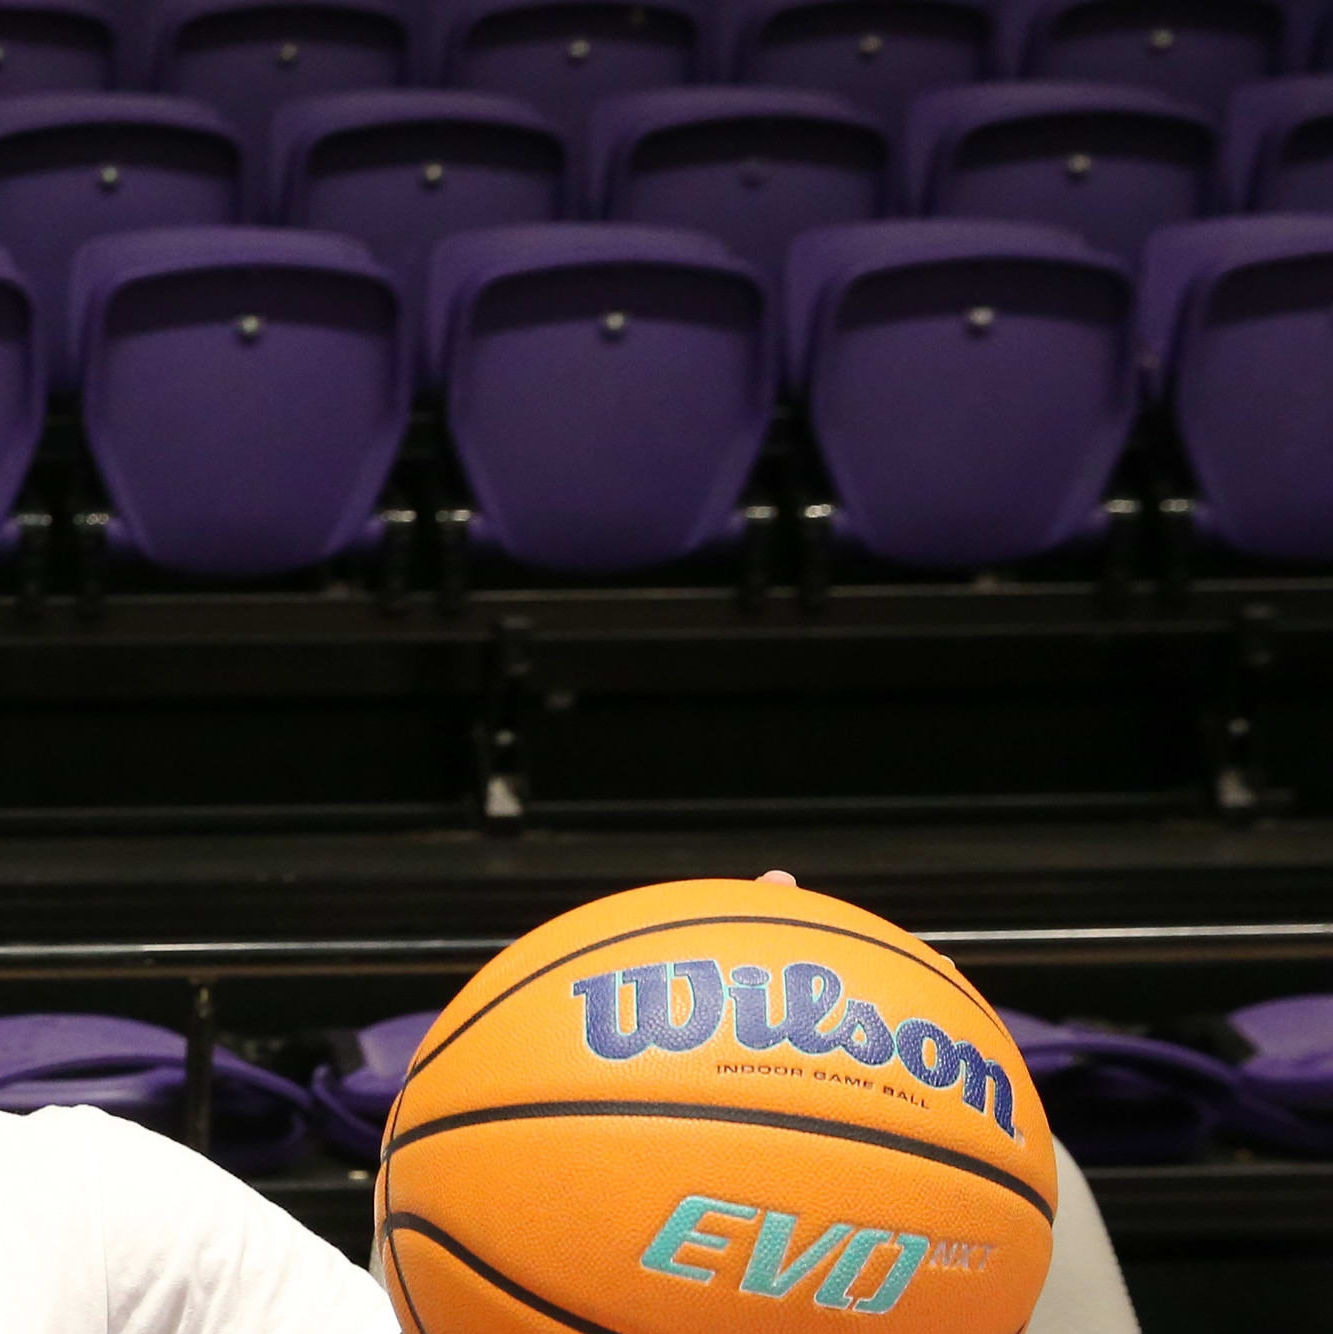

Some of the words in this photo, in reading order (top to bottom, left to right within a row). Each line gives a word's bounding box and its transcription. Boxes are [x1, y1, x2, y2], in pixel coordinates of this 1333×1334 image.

[571, 959, 1017, 1140] Wilson
[716, 1064, 804, 1078] INDOOR
[813, 1071, 874, 1090] GAME
[882, 1086, 930, 1110] BALL
[639, 1195, 931, 1314] EVO
[929, 1239, 997, 1270] NXT
